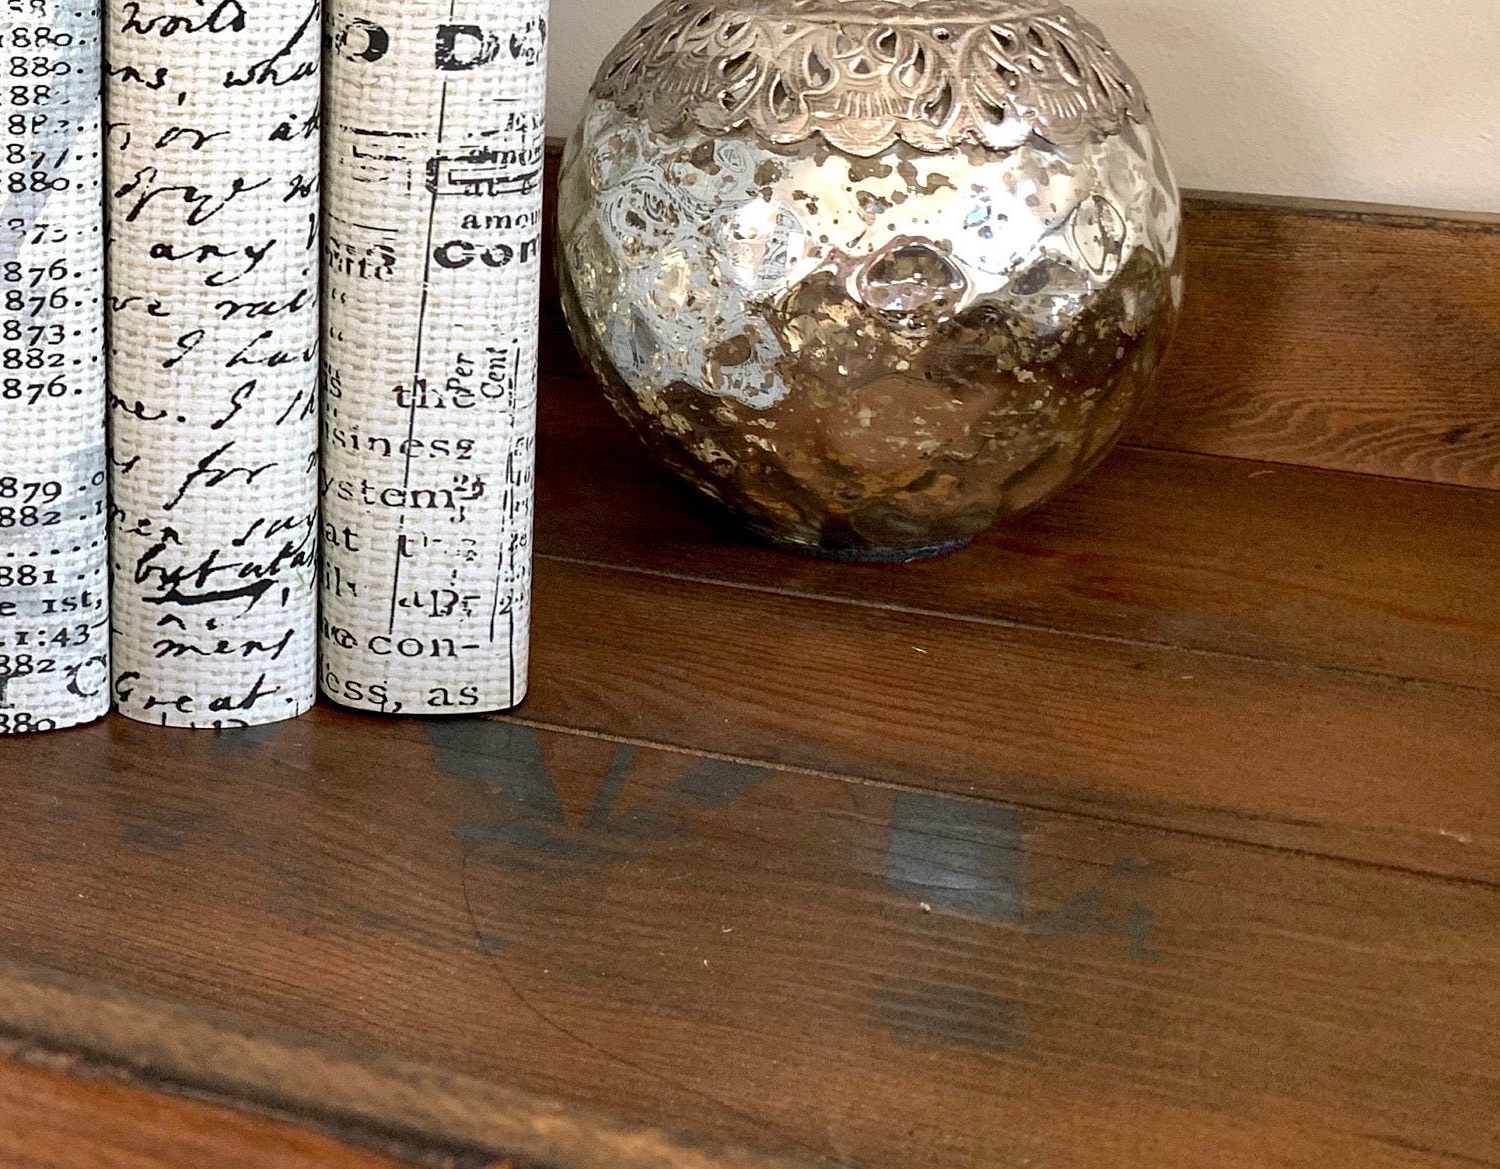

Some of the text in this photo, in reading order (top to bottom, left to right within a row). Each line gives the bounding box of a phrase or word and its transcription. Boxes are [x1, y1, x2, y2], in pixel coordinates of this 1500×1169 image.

[150, 238, 277, 287] any
[162, 440, 279, 511] for
[368, 634, 481, 658] con-
[426, 684, 479, 707] as
